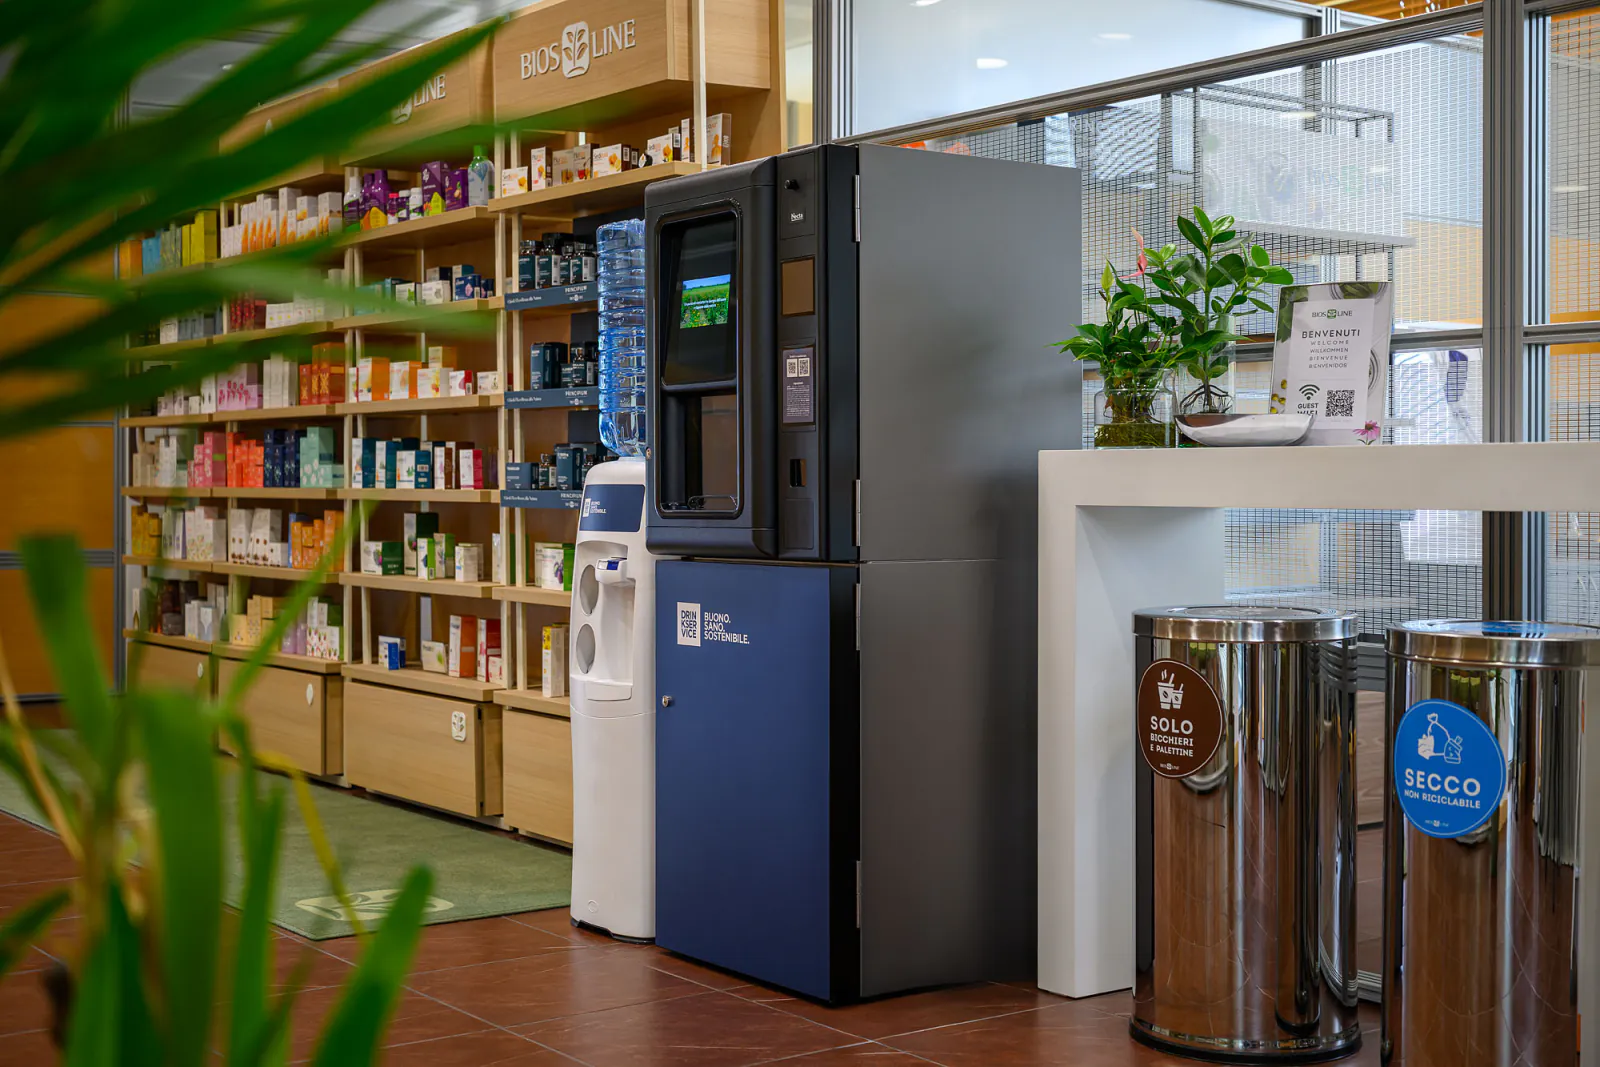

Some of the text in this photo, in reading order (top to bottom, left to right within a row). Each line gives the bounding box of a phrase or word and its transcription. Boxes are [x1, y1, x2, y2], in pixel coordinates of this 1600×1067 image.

[520, 18, 637, 80] BIOS LINE
[414, 74, 446, 107] LINE
[1301, 329, 1361, 339] BENVENUTI
[681, 610, 697, 620] DRIN
[704, 612, 731, 623] BUONO.
[681, 620, 697, 629] KSER
[704, 621, 726, 632] SANO.
[681, 629, 697, 638] VICE
[704, 631, 750, 644] SOSTENIBILE.
[1150, 715, 1194, 735] SOLO
[1150, 732, 1194, 747] BICCHIERI
[1150, 743, 1194, 757] E PALETTINE
[1404, 768, 1481, 797] SECCO
[1404, 789, 1481, 809] NON RICICLABILE
